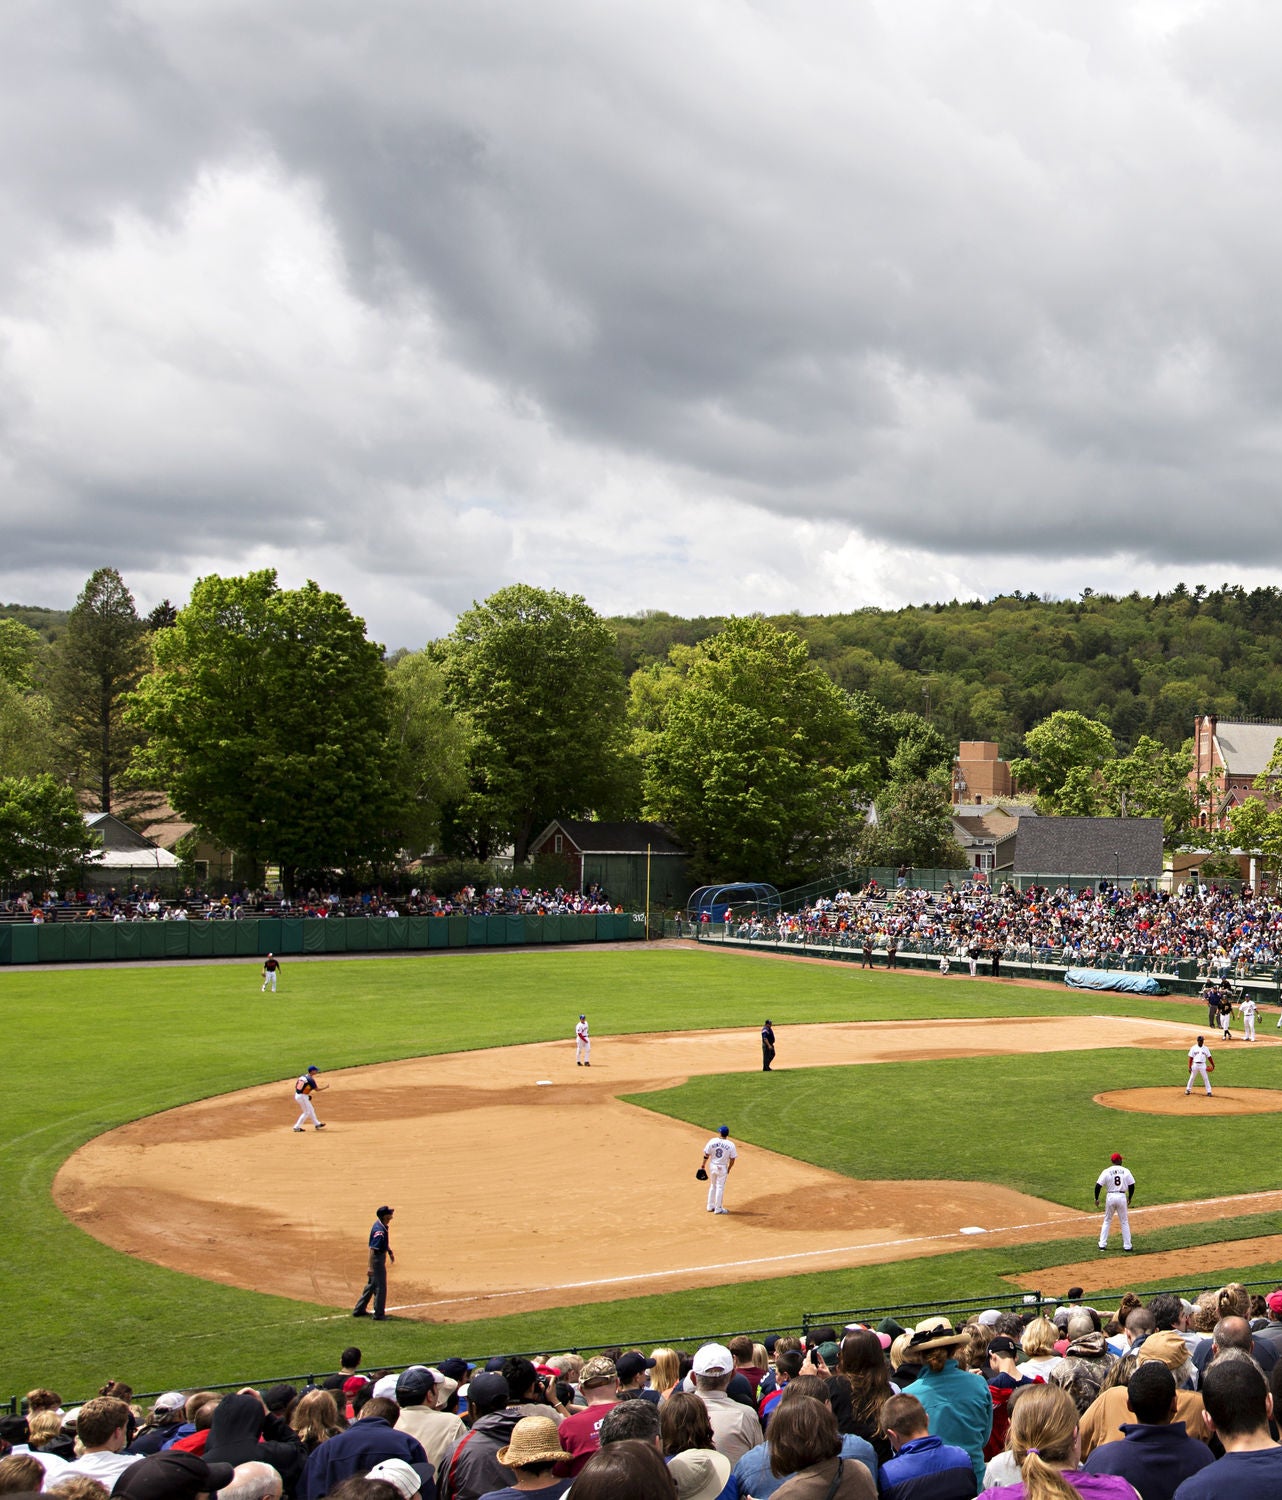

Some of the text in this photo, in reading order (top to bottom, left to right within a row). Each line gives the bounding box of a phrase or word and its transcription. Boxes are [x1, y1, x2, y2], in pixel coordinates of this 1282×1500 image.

[632, 912, 645, 922] 312
[715, 1148, 724, 1159] 8
[1114, 1176, 1121, 1186] 8
